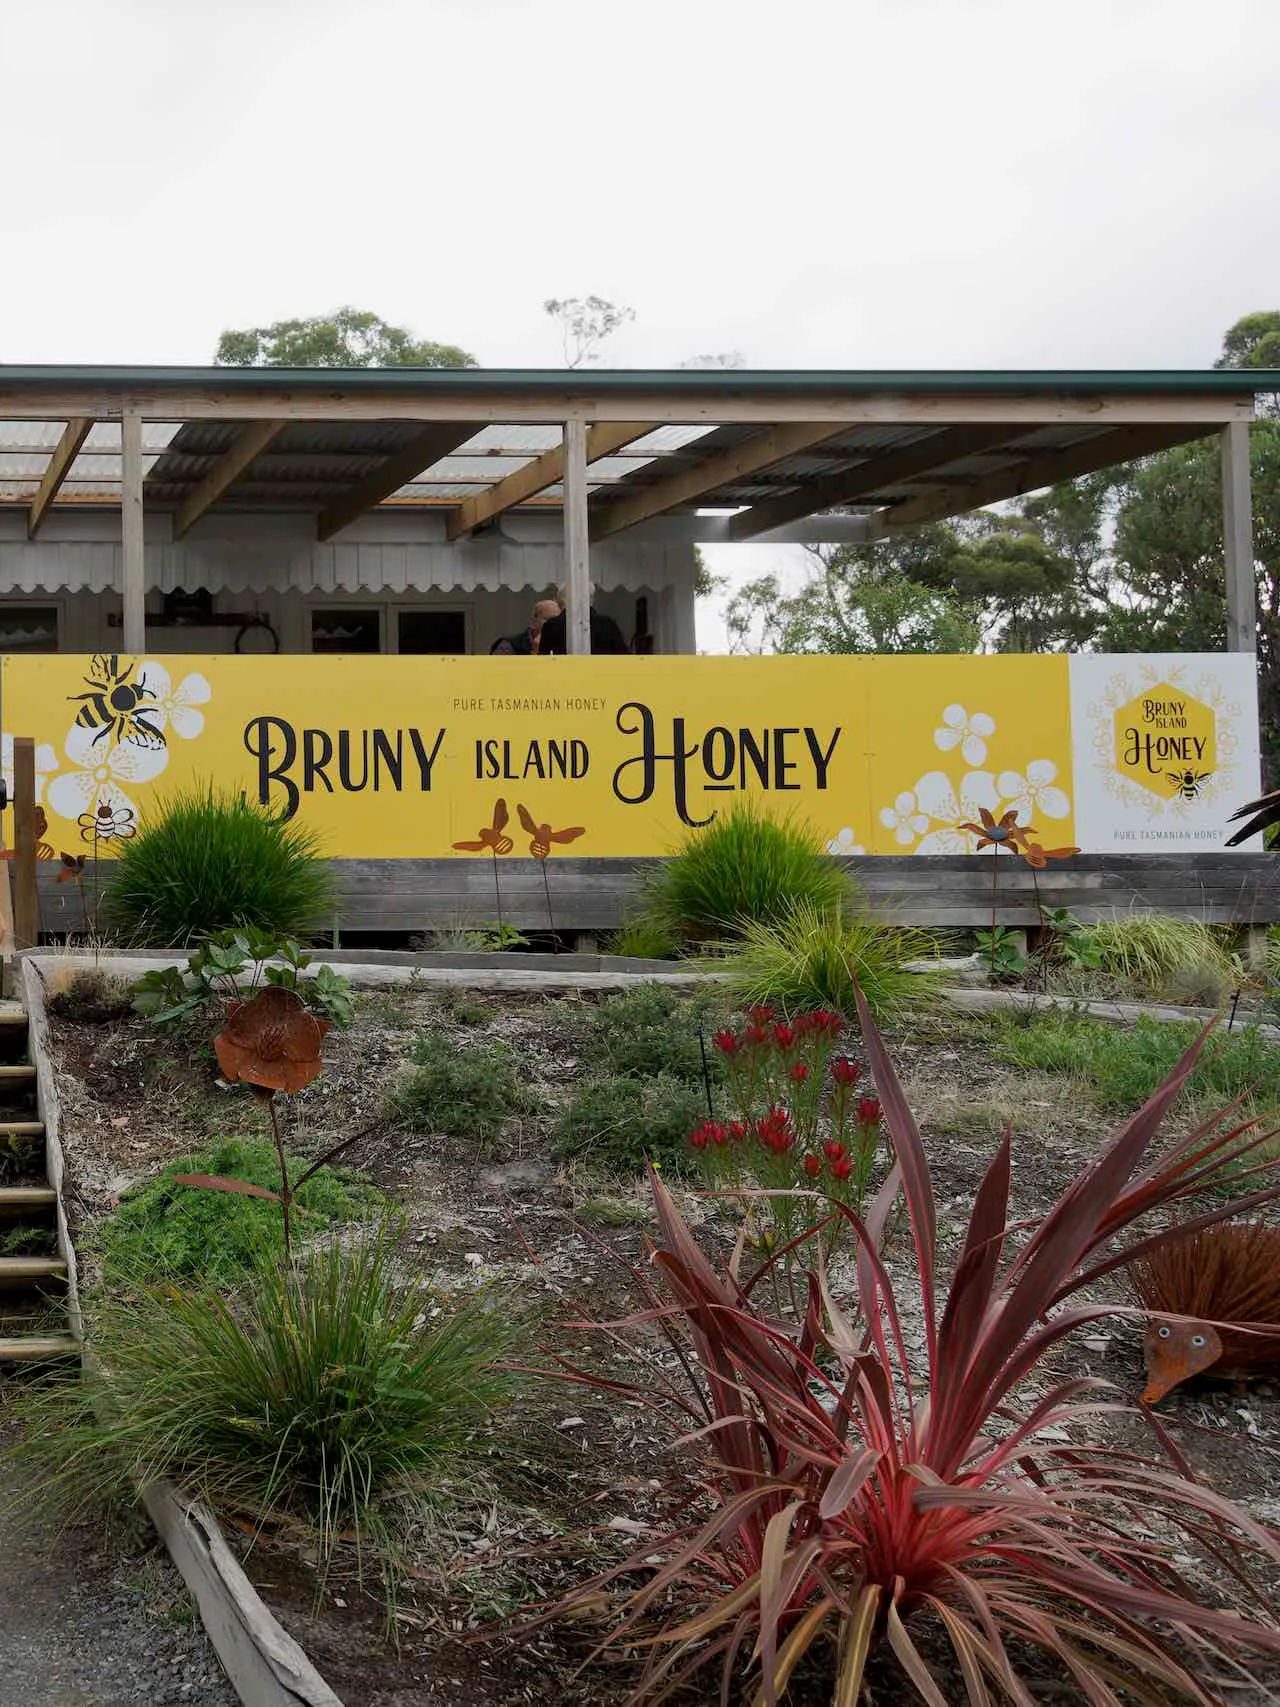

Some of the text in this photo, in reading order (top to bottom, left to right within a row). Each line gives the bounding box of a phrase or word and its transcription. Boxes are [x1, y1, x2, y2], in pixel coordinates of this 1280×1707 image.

[453, 698, 607, 711] PURE TASMANIAN HONEY
[1142, 699, 1186, 723] BRUNY
[1155, 717, 1188, 729] ISLAND
[1124, 727, 1207, 774] HONEY
[243, 702, 842, 828] BRUNY ISLAND HONEY
[1114, 830, 1223, 841] PURE TASMANIAN HONEY
